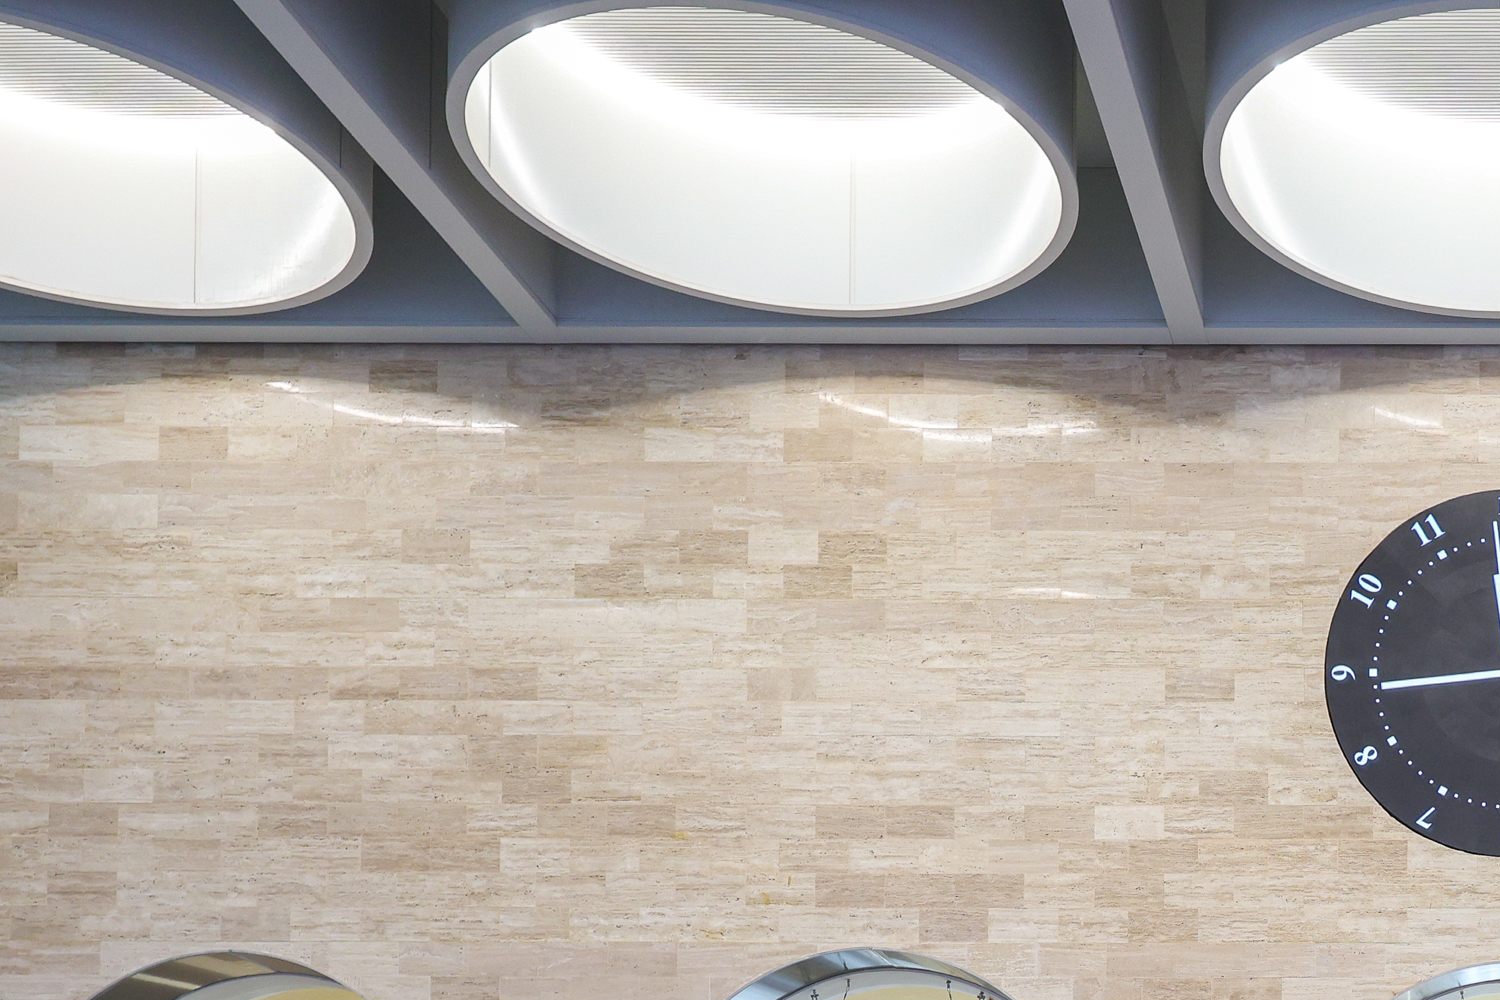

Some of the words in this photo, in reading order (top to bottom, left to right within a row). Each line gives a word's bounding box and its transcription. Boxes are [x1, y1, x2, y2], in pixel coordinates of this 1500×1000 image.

[1410, 513, 1446, 547] 11
[1350, 574, 1382, 609] 10
[1330, 665, 1356, 681] 9
[1354, 745, 1378, 766] 8
[1415, 806, 1436, 829] 7
